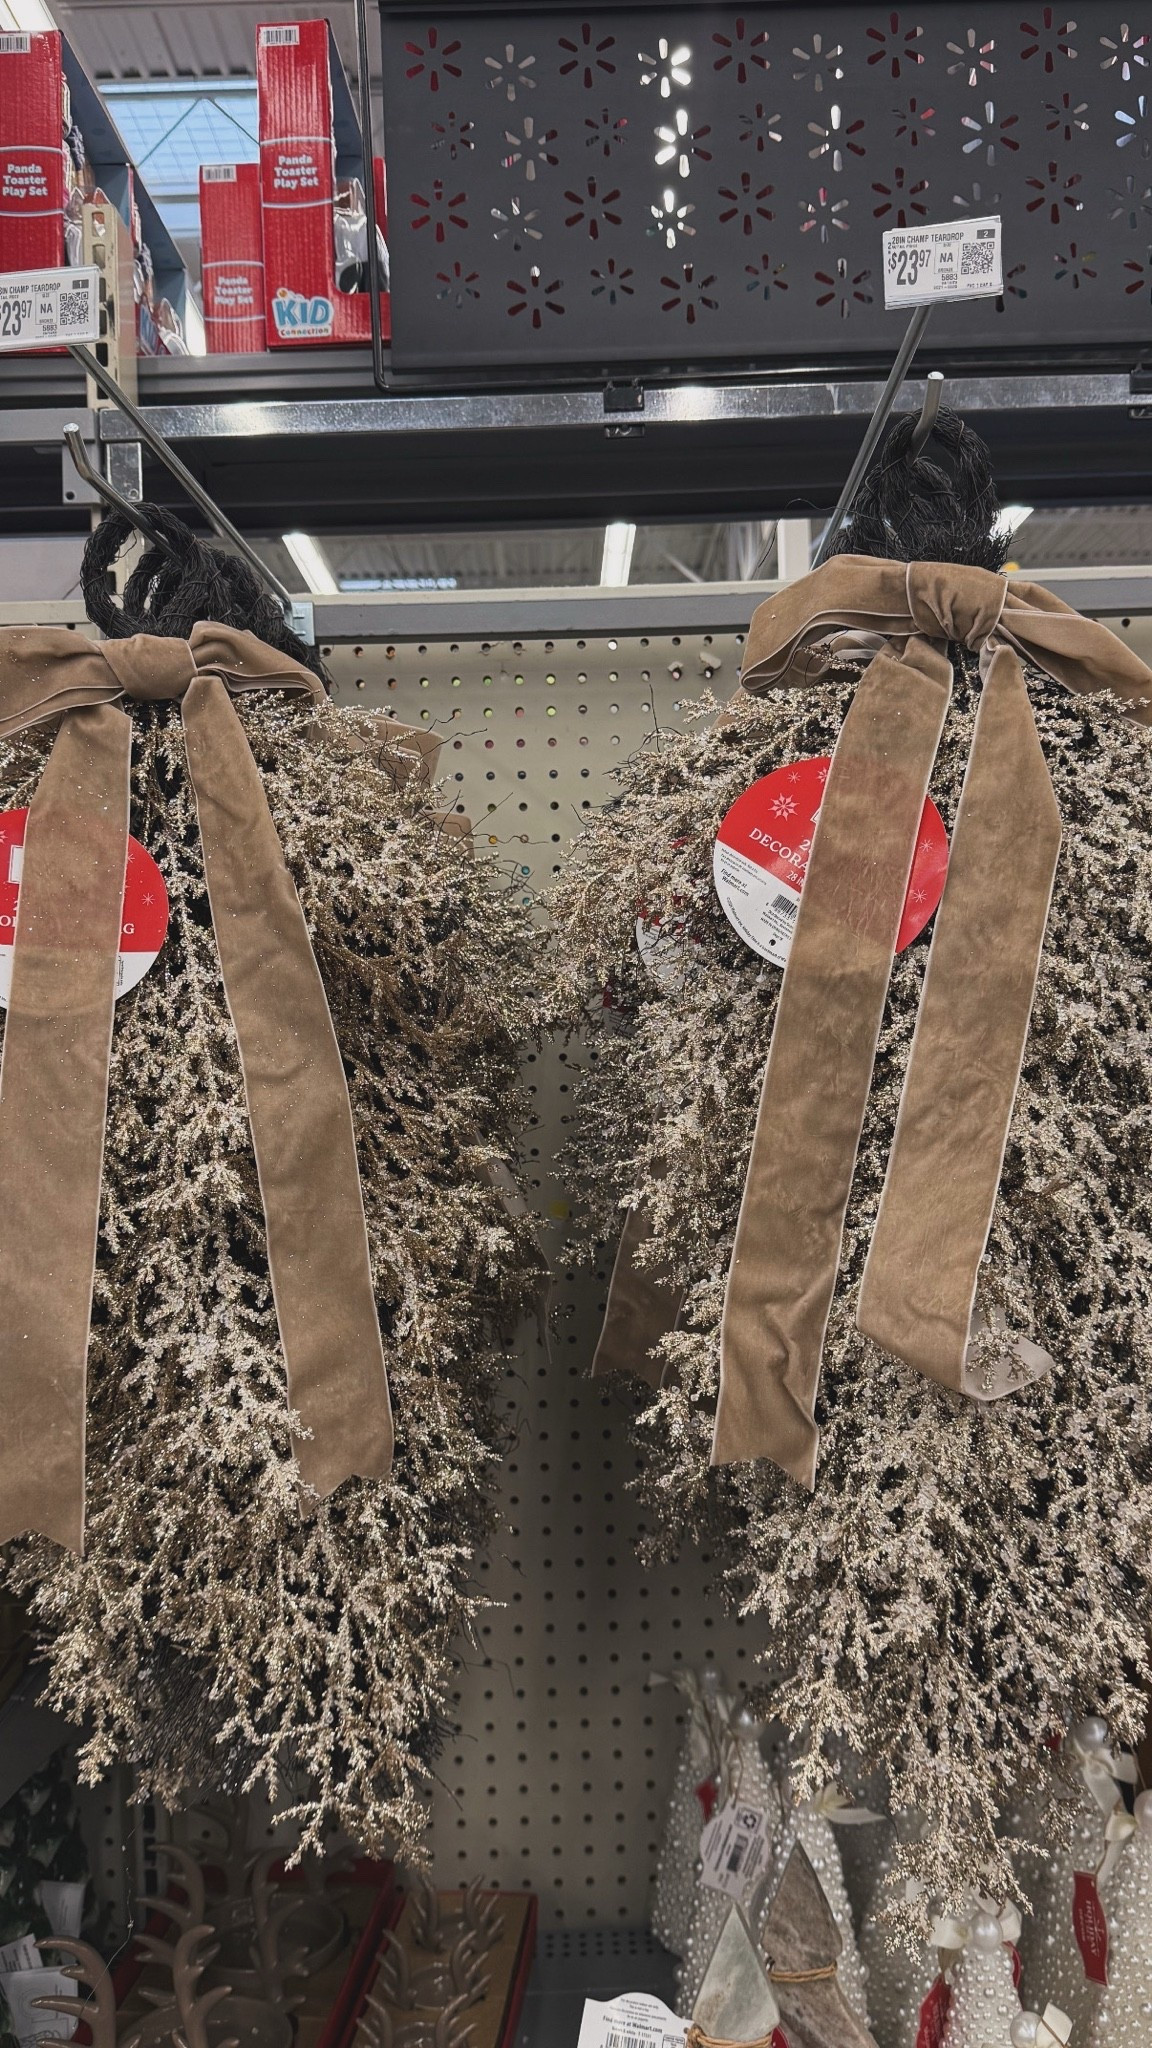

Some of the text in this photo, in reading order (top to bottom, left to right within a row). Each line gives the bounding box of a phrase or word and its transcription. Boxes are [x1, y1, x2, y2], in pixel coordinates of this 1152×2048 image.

[278, 154, 313, 165] Panda
[7, 163, 42, 173] Panda
[274, 166, 318, 177] Toaster
[2, 175, 47, 184] Toaster
[273, 177, 319, 190] Play Set
[2, 186, 48, 198] Play Set
[907, 235, 929, 244] CHAMP
[931, 232, 964, 242] TEARDROP
[940, 252, 953, 263] NA
[9, 285, 30, 294] CHAMP
[31, 282, 61, 293] TEARDROP
[40, 303, 53, 314] NA
[275, 299, 330, 326] KID
